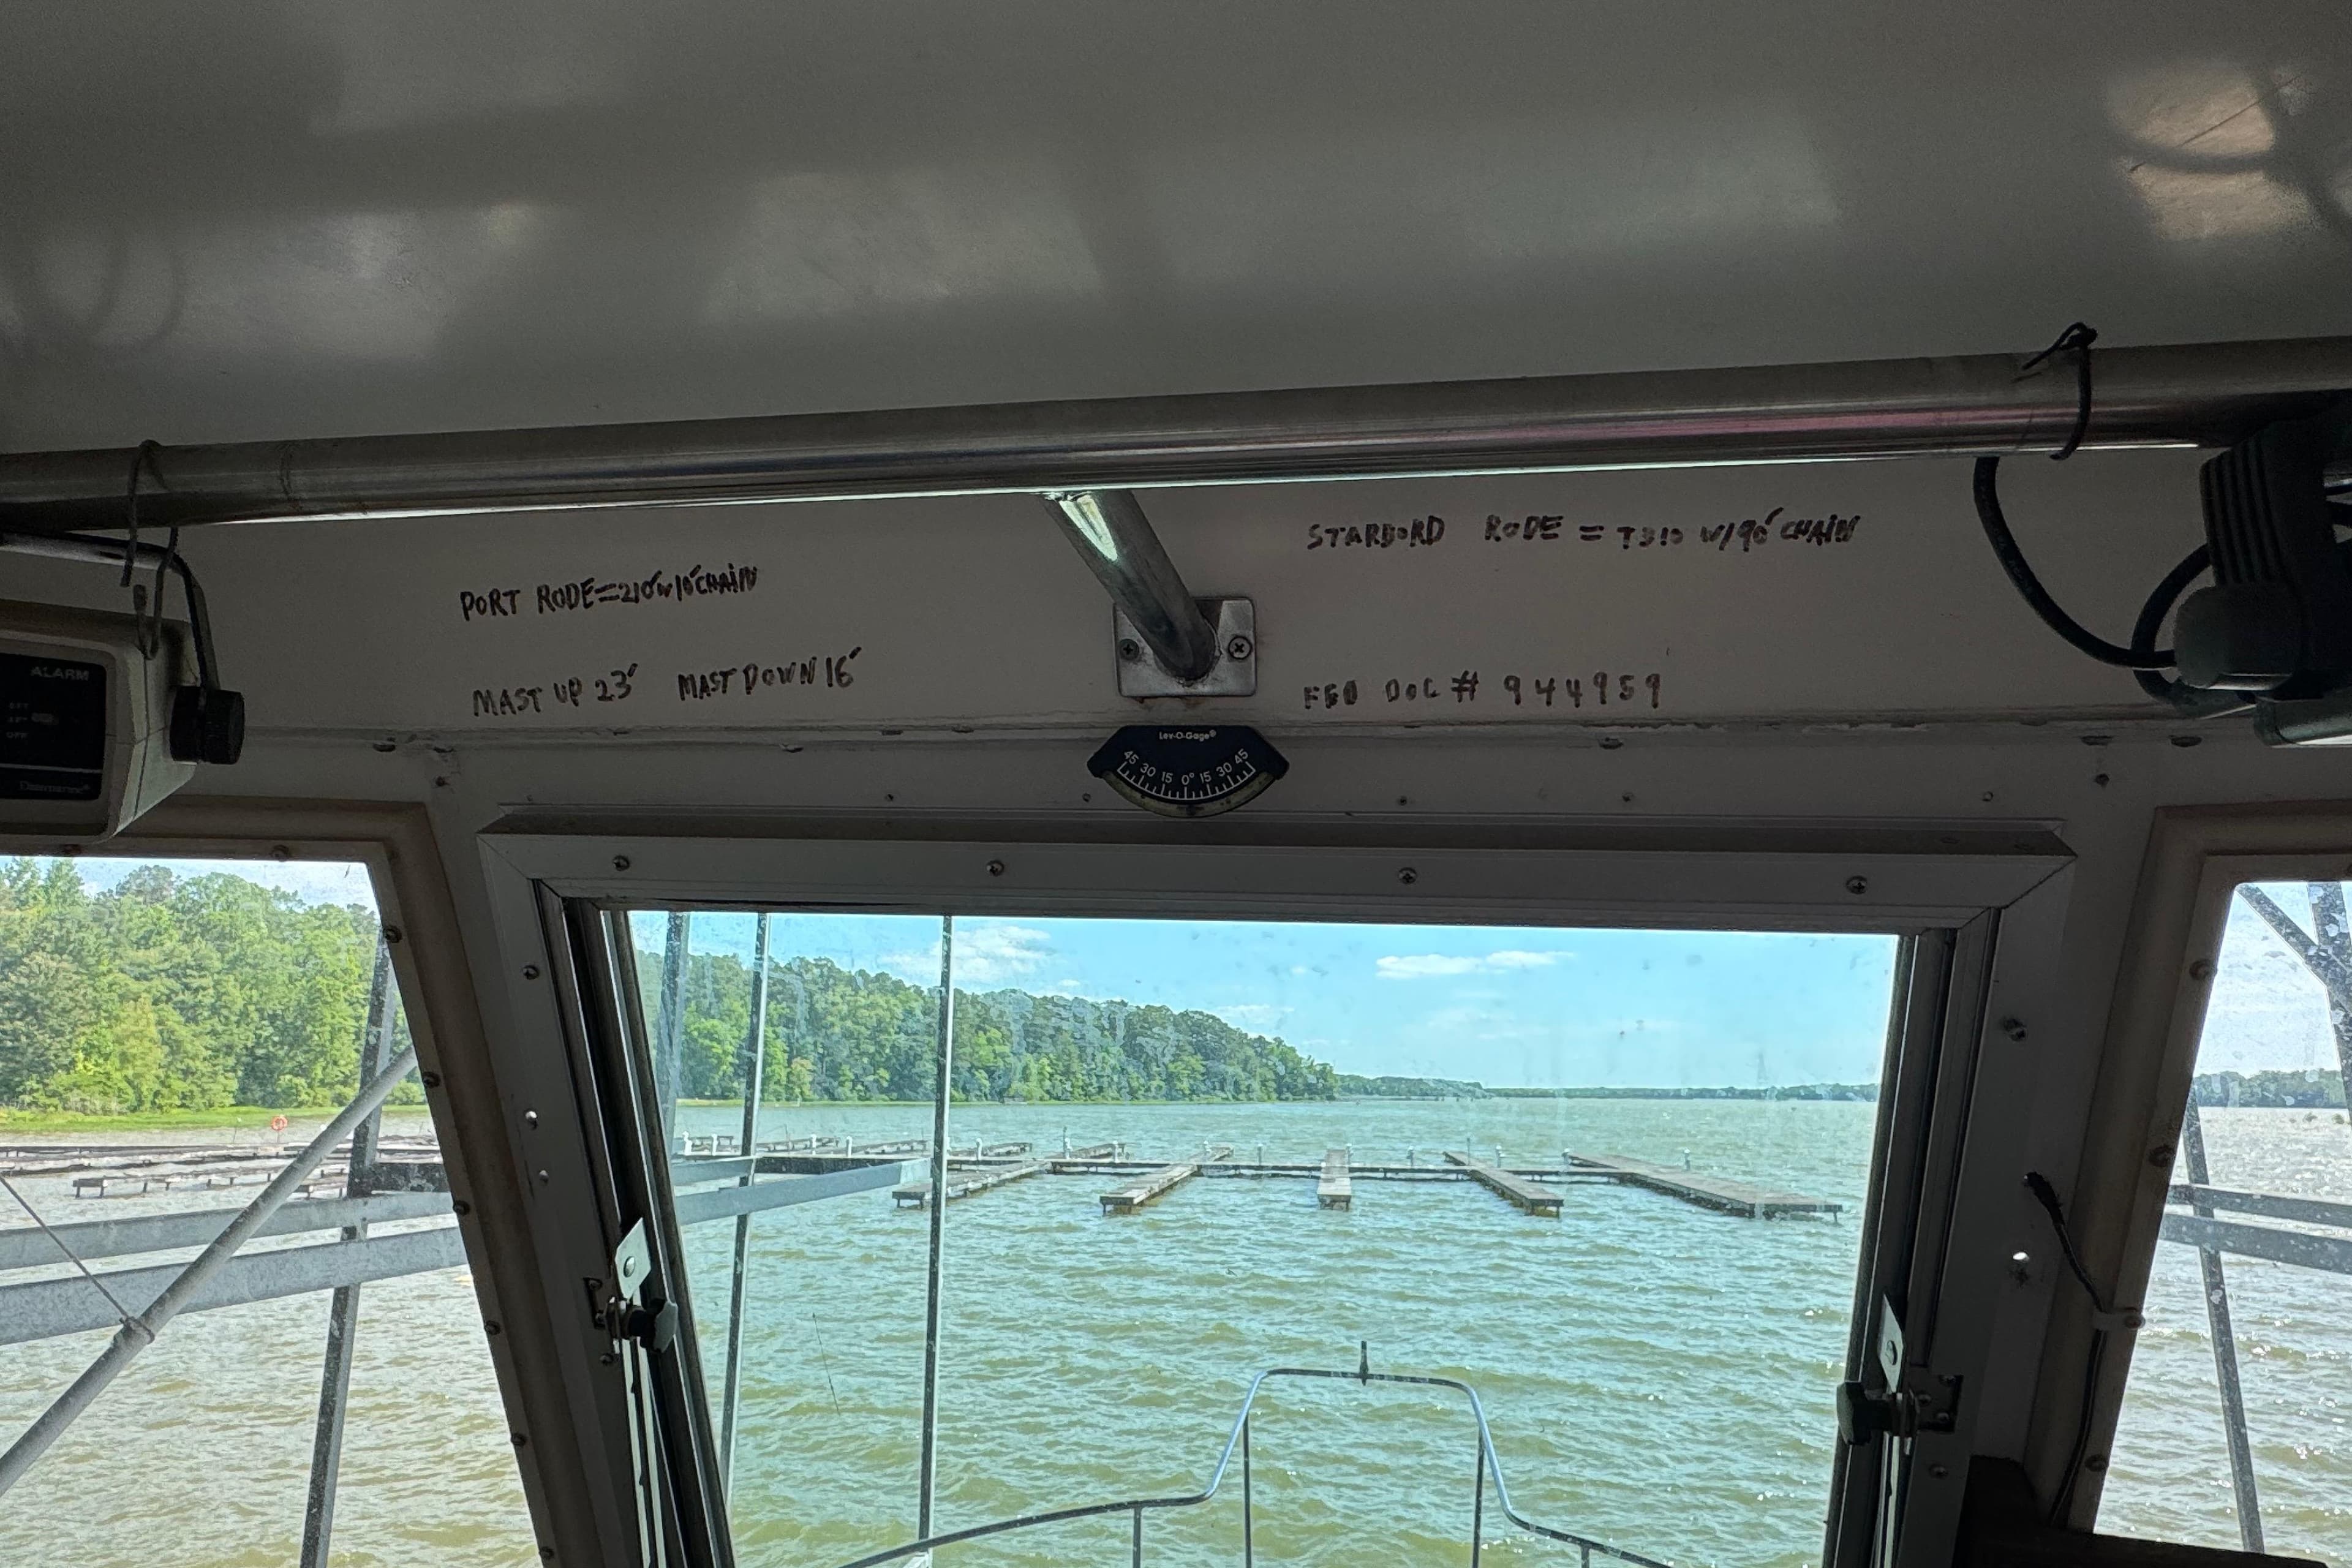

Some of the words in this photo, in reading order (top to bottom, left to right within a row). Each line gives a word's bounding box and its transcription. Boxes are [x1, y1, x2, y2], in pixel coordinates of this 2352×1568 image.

[1307, 514, 1445, 550] STARBORD
[1484, 514, 1564, 543] RODE
[1779, 513, 1861, 546] CHAIN
[460, 589, 521, 621] PORT
[31, 666, 89, 680] ALARM
[678, 668, 737, 701] MAST
[473, 687, 543, 717] MAST
[554, 677, 582, 707] UP
[1385, 677, 1441, 703] DOC
[1124, 751, 1139, 764] 45
[1140, 763, 1156, 777] 30
[1161, 772, 1174, 783] 15
[1199, 771, 1212, 783] 15
[1216, 763, 1232, 777] 30
[1234, 748, 1249, 764] 45
